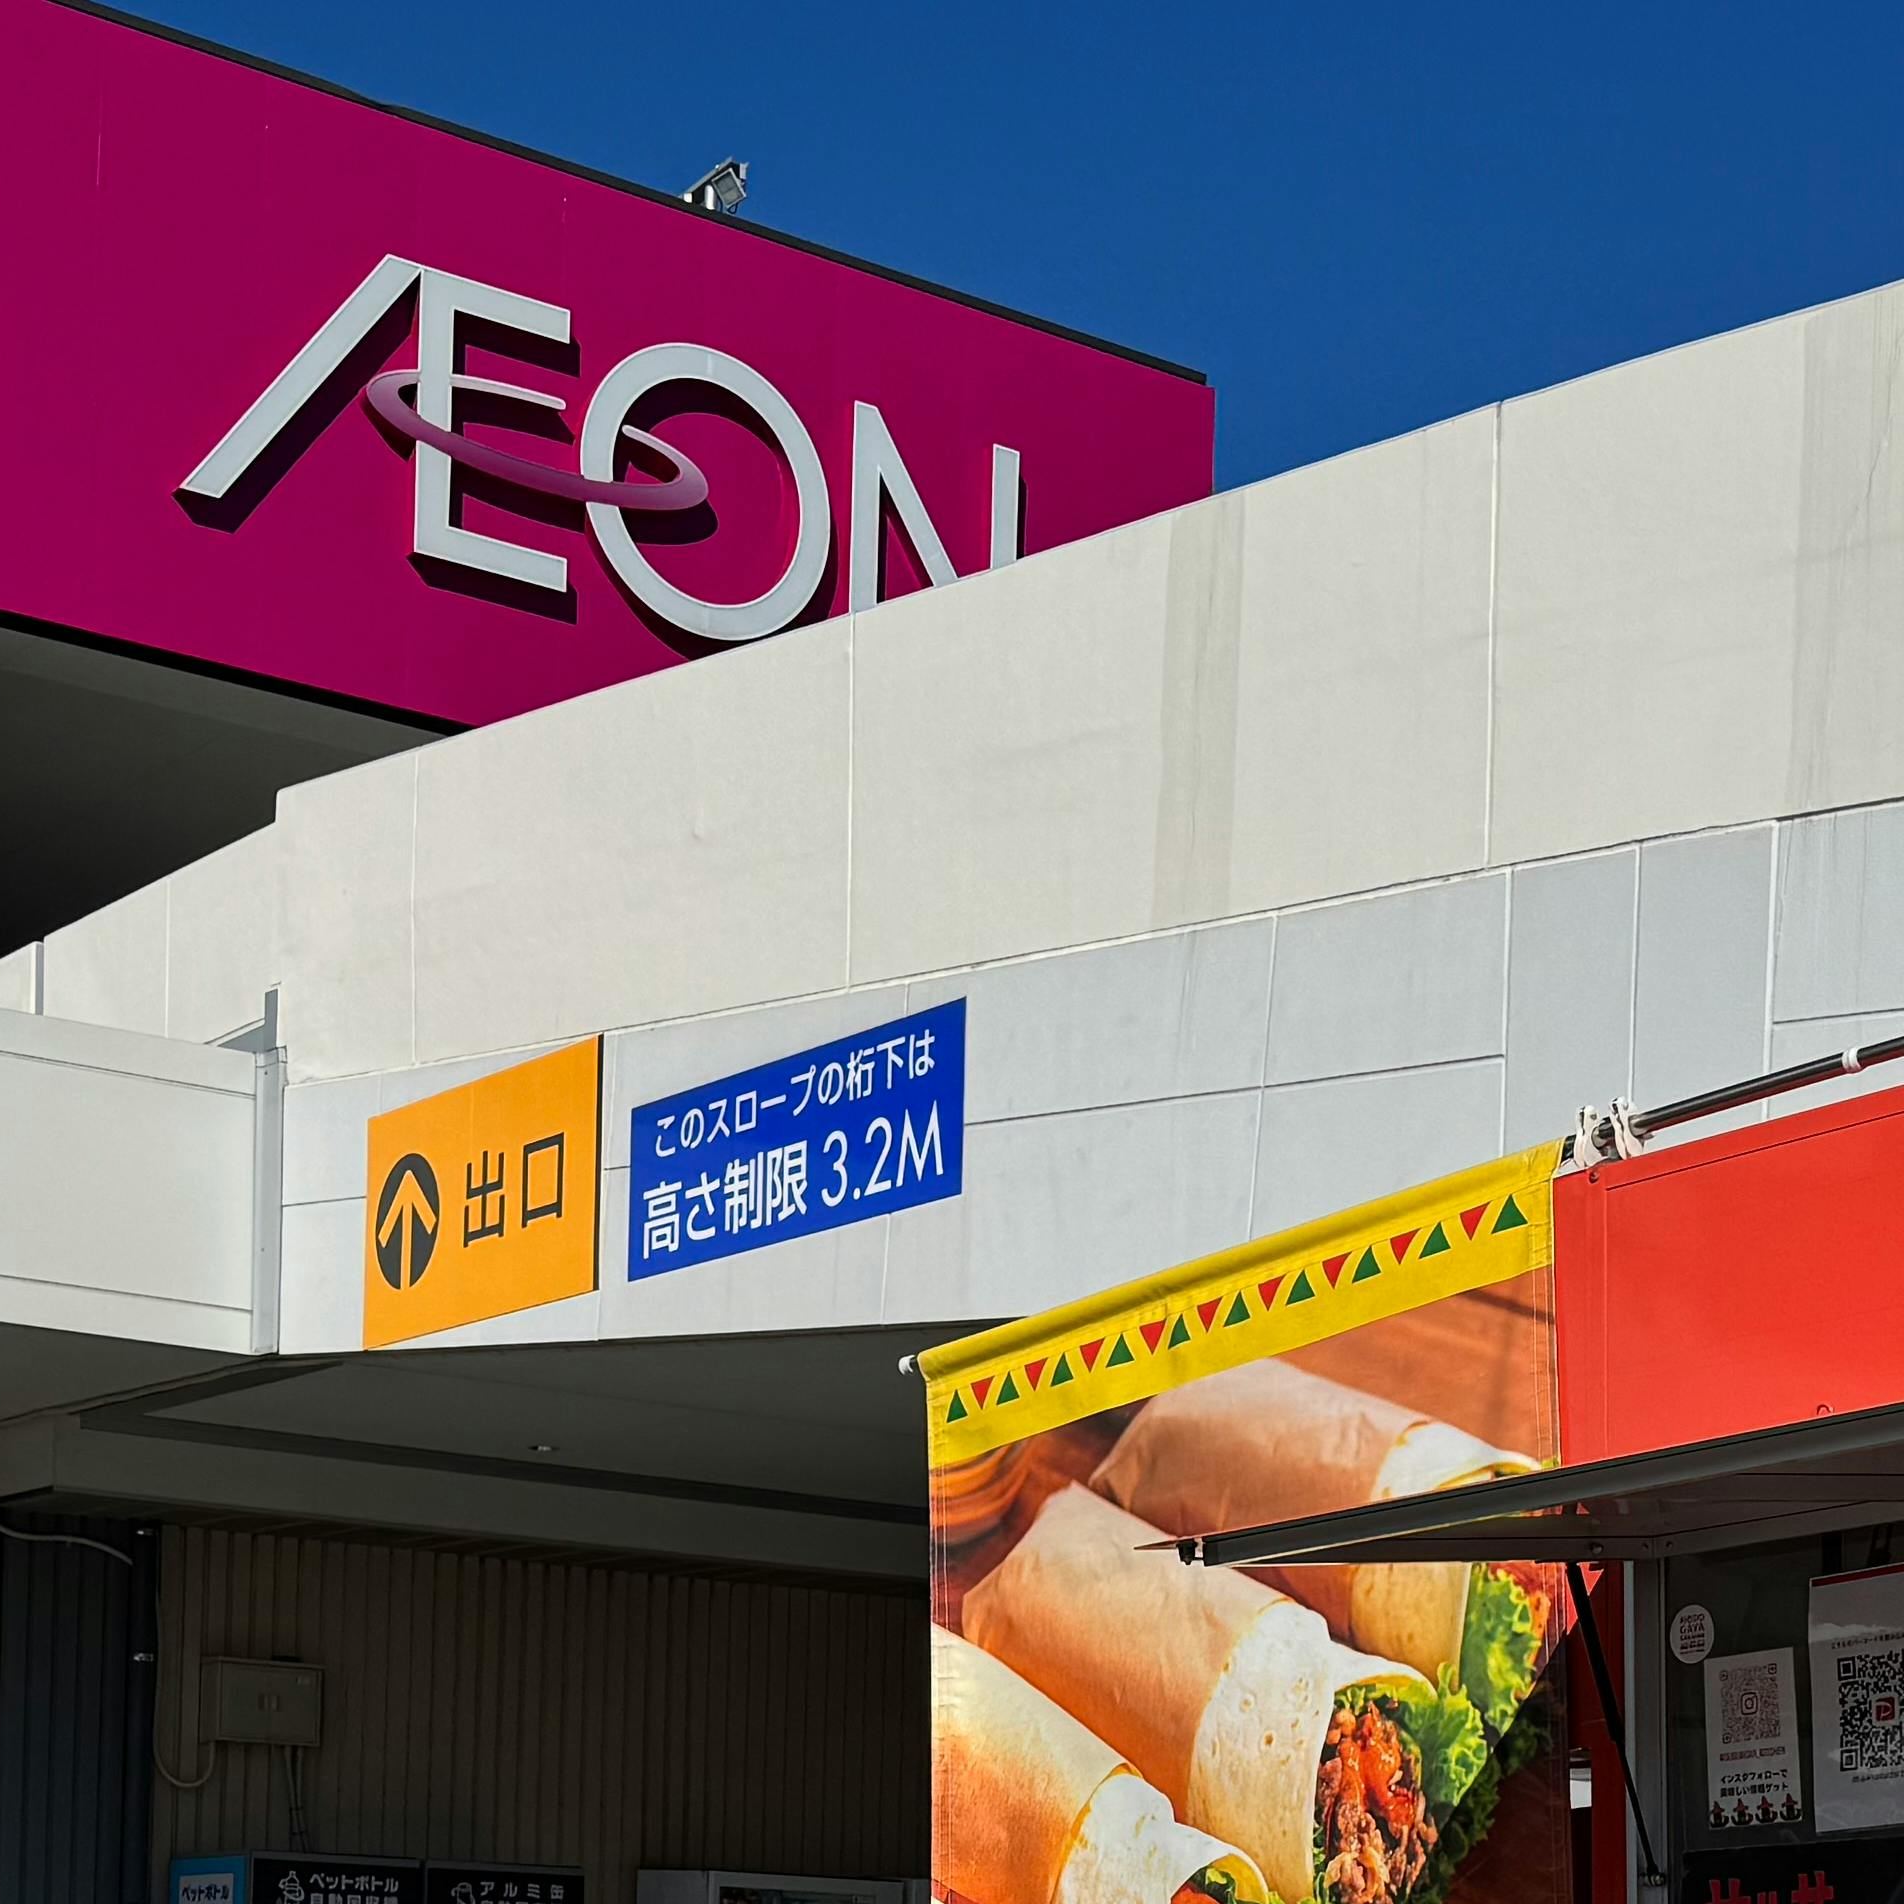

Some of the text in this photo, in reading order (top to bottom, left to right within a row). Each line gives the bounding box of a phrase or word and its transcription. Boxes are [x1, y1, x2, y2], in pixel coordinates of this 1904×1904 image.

[653, 1027, 936, 1156] このスロープの桁下は
[462, 1130, 567, 1247] 出口
[640, 1106, 945, 1262] 高さ制限 3.2M
[308, 1872, 400, 1893] ペットボトル
